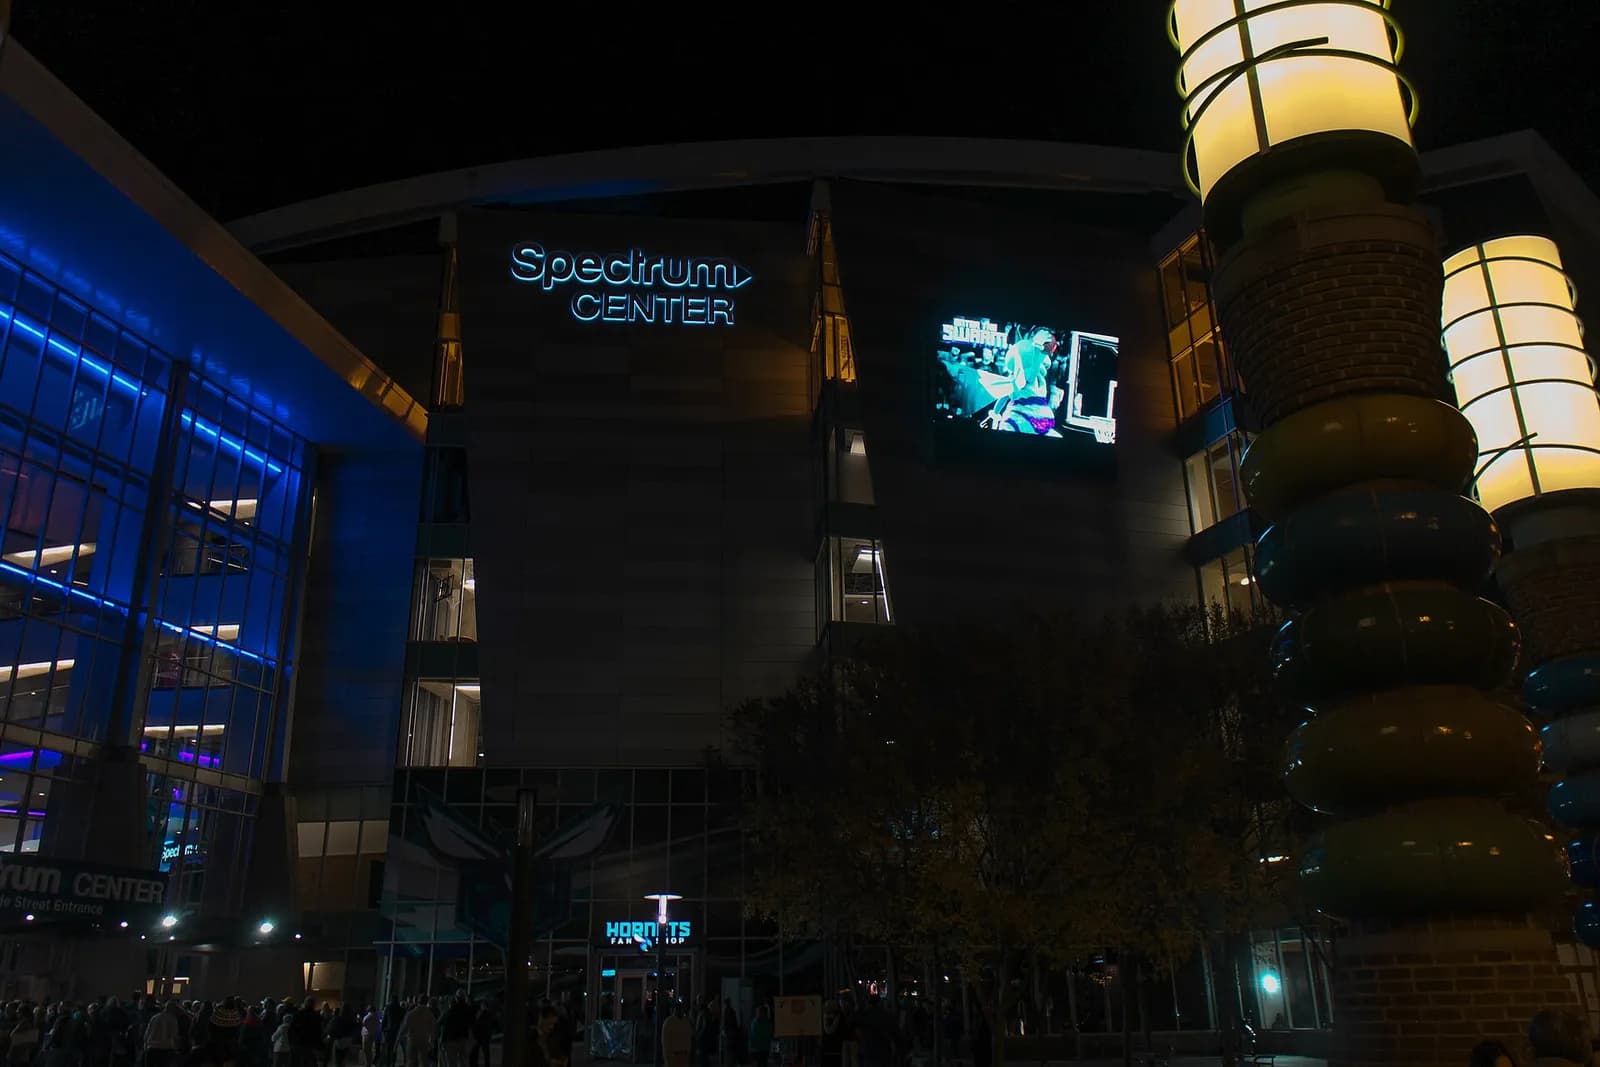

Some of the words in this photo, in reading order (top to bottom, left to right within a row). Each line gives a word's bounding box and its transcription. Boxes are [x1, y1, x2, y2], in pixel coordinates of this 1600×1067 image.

[511, 241, 735, 290] Spectrum
[571, 292, 735, 325] CENTER
[0, 864, 61, 894] rum
[74, 872, 164, 903] CENTER
[14, 897, 51, 912] Street
[54, 899, 103, 914] Entrance
[606, 921, 691, 937] HORNTS
